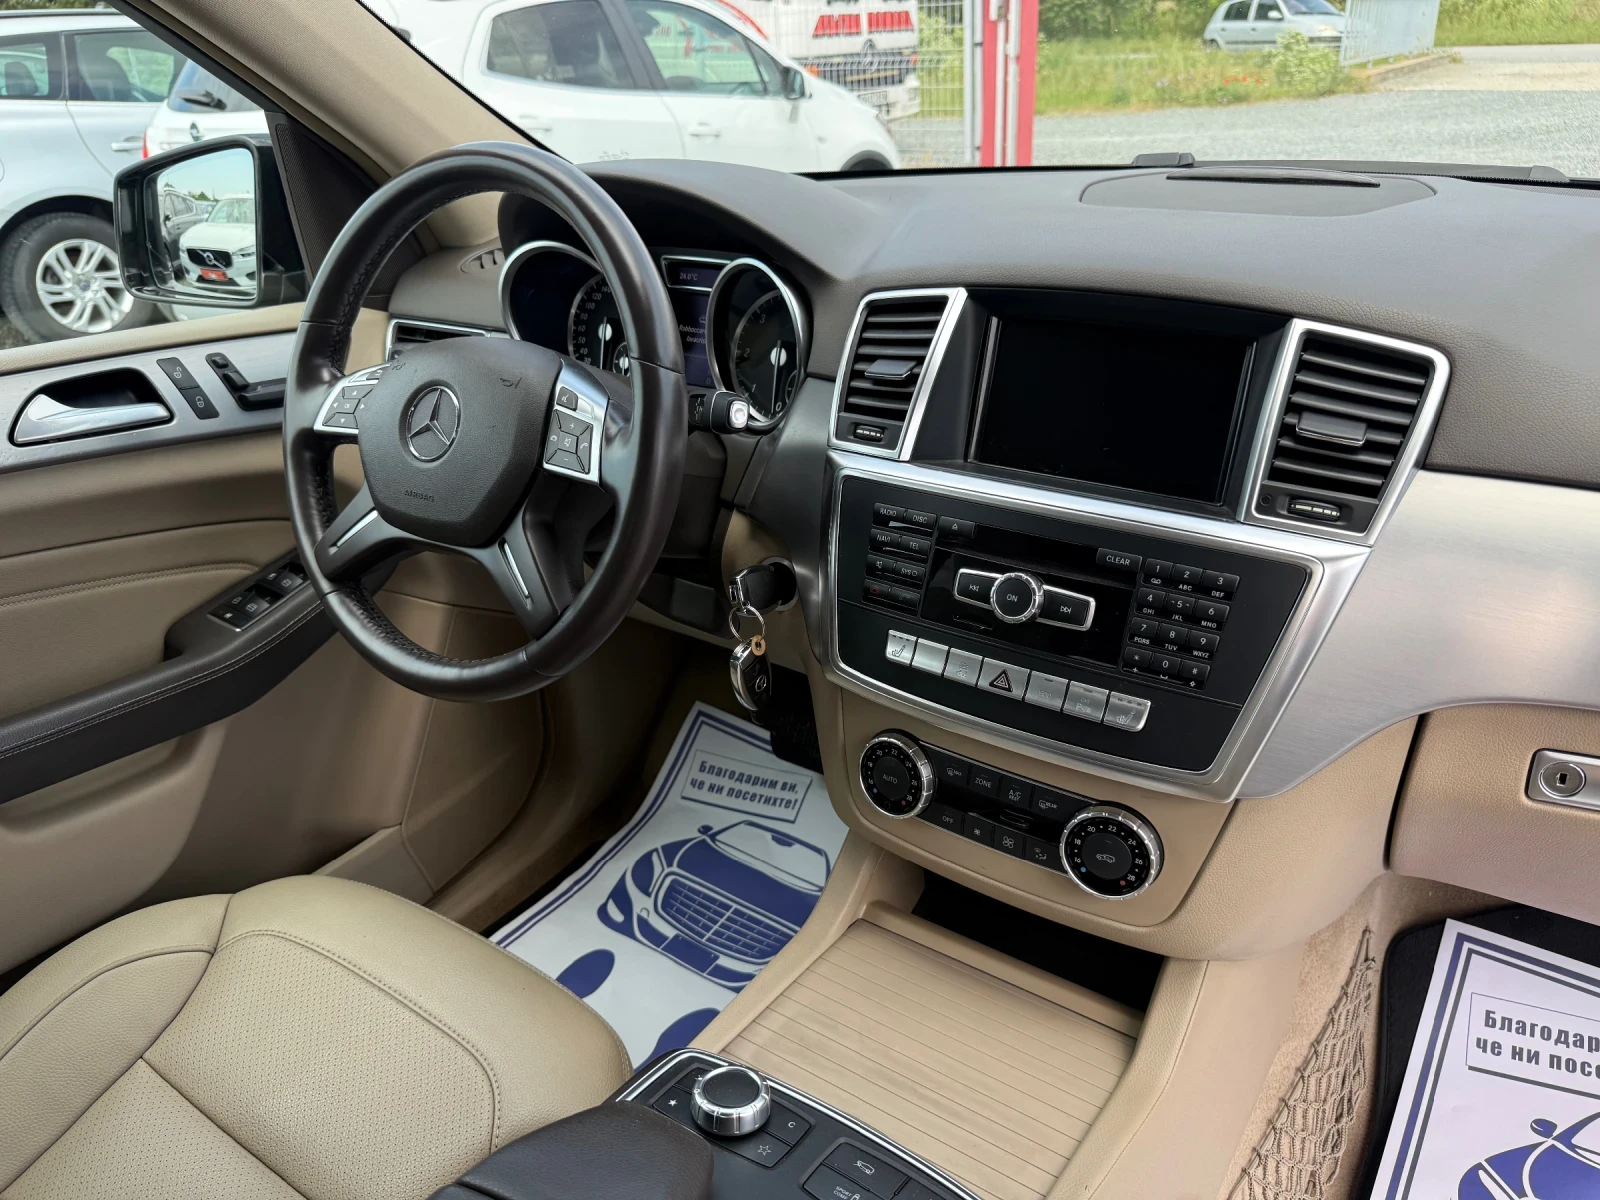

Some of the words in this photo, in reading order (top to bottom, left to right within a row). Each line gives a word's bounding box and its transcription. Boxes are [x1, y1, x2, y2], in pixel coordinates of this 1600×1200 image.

[585, 302, 596, 310] 100
[760, 314, 765, 324] 3
[578, 336, 586, 344] 50
[744, 348, 750, 357] 2
[752, 384, 756, 392] 1
[776, 402, 782, 411] 0
[880, 508, 897, 517] RADIO
[912, 515, 928, 523] DISC
[876, 534, 890, 543] NAVI
[909, 542, 919, 550] TEL
[1106, 555, 1131, 566] CLEAR
[1184, 570, 1190, 578] 2
[1216, 577, 1224, 585] 3
[1006, 593, 1018, 602] ON
[1147, 594, 1153, 602] 4
[1211, 590, 1224, 598] DEF
[1177, 600, 1182, 608] 5
[1208, 607, 1214, 615] 6
[1172, 614, 1183, 622] JKL
[1140, 624, 1146, 632] 7
[1201, 620, 1217, 629] MNO
[1169, 630, 1176, 638] 8
[1134, 636, 1150, 645] PQRS
[1200, 637, 1206, 646] 9
[1164, 643, 1178, 651] TUV
[1192, 650, 1210, 659] WXYZ
[1162, 660, 1168, 668] 0
[698, 760, 778, 789] Благодарим
[780, 782, 799, 794] ви,
[882, 774, 898, 784] AUTO
[975, 777, 992, 788] ZONE
[690, 777, 704, 789] че
[707, 783, 723, 795] ни
[726, 787, 798, 810] посетихте!
[1009, 789, 1021, 798] A/C
[942, 815, 954, 824] OFF
[1128, 838, 1137, 846] 24
[1484, 1009, 1600, 1053] Благодар
[1476, 1036, 1502, 1057] че
[1511, 1045, 1540, 1066] ни
[833, 1190, 849, 1200] COMF
[836, 1186, 852, 1197] SPORT
